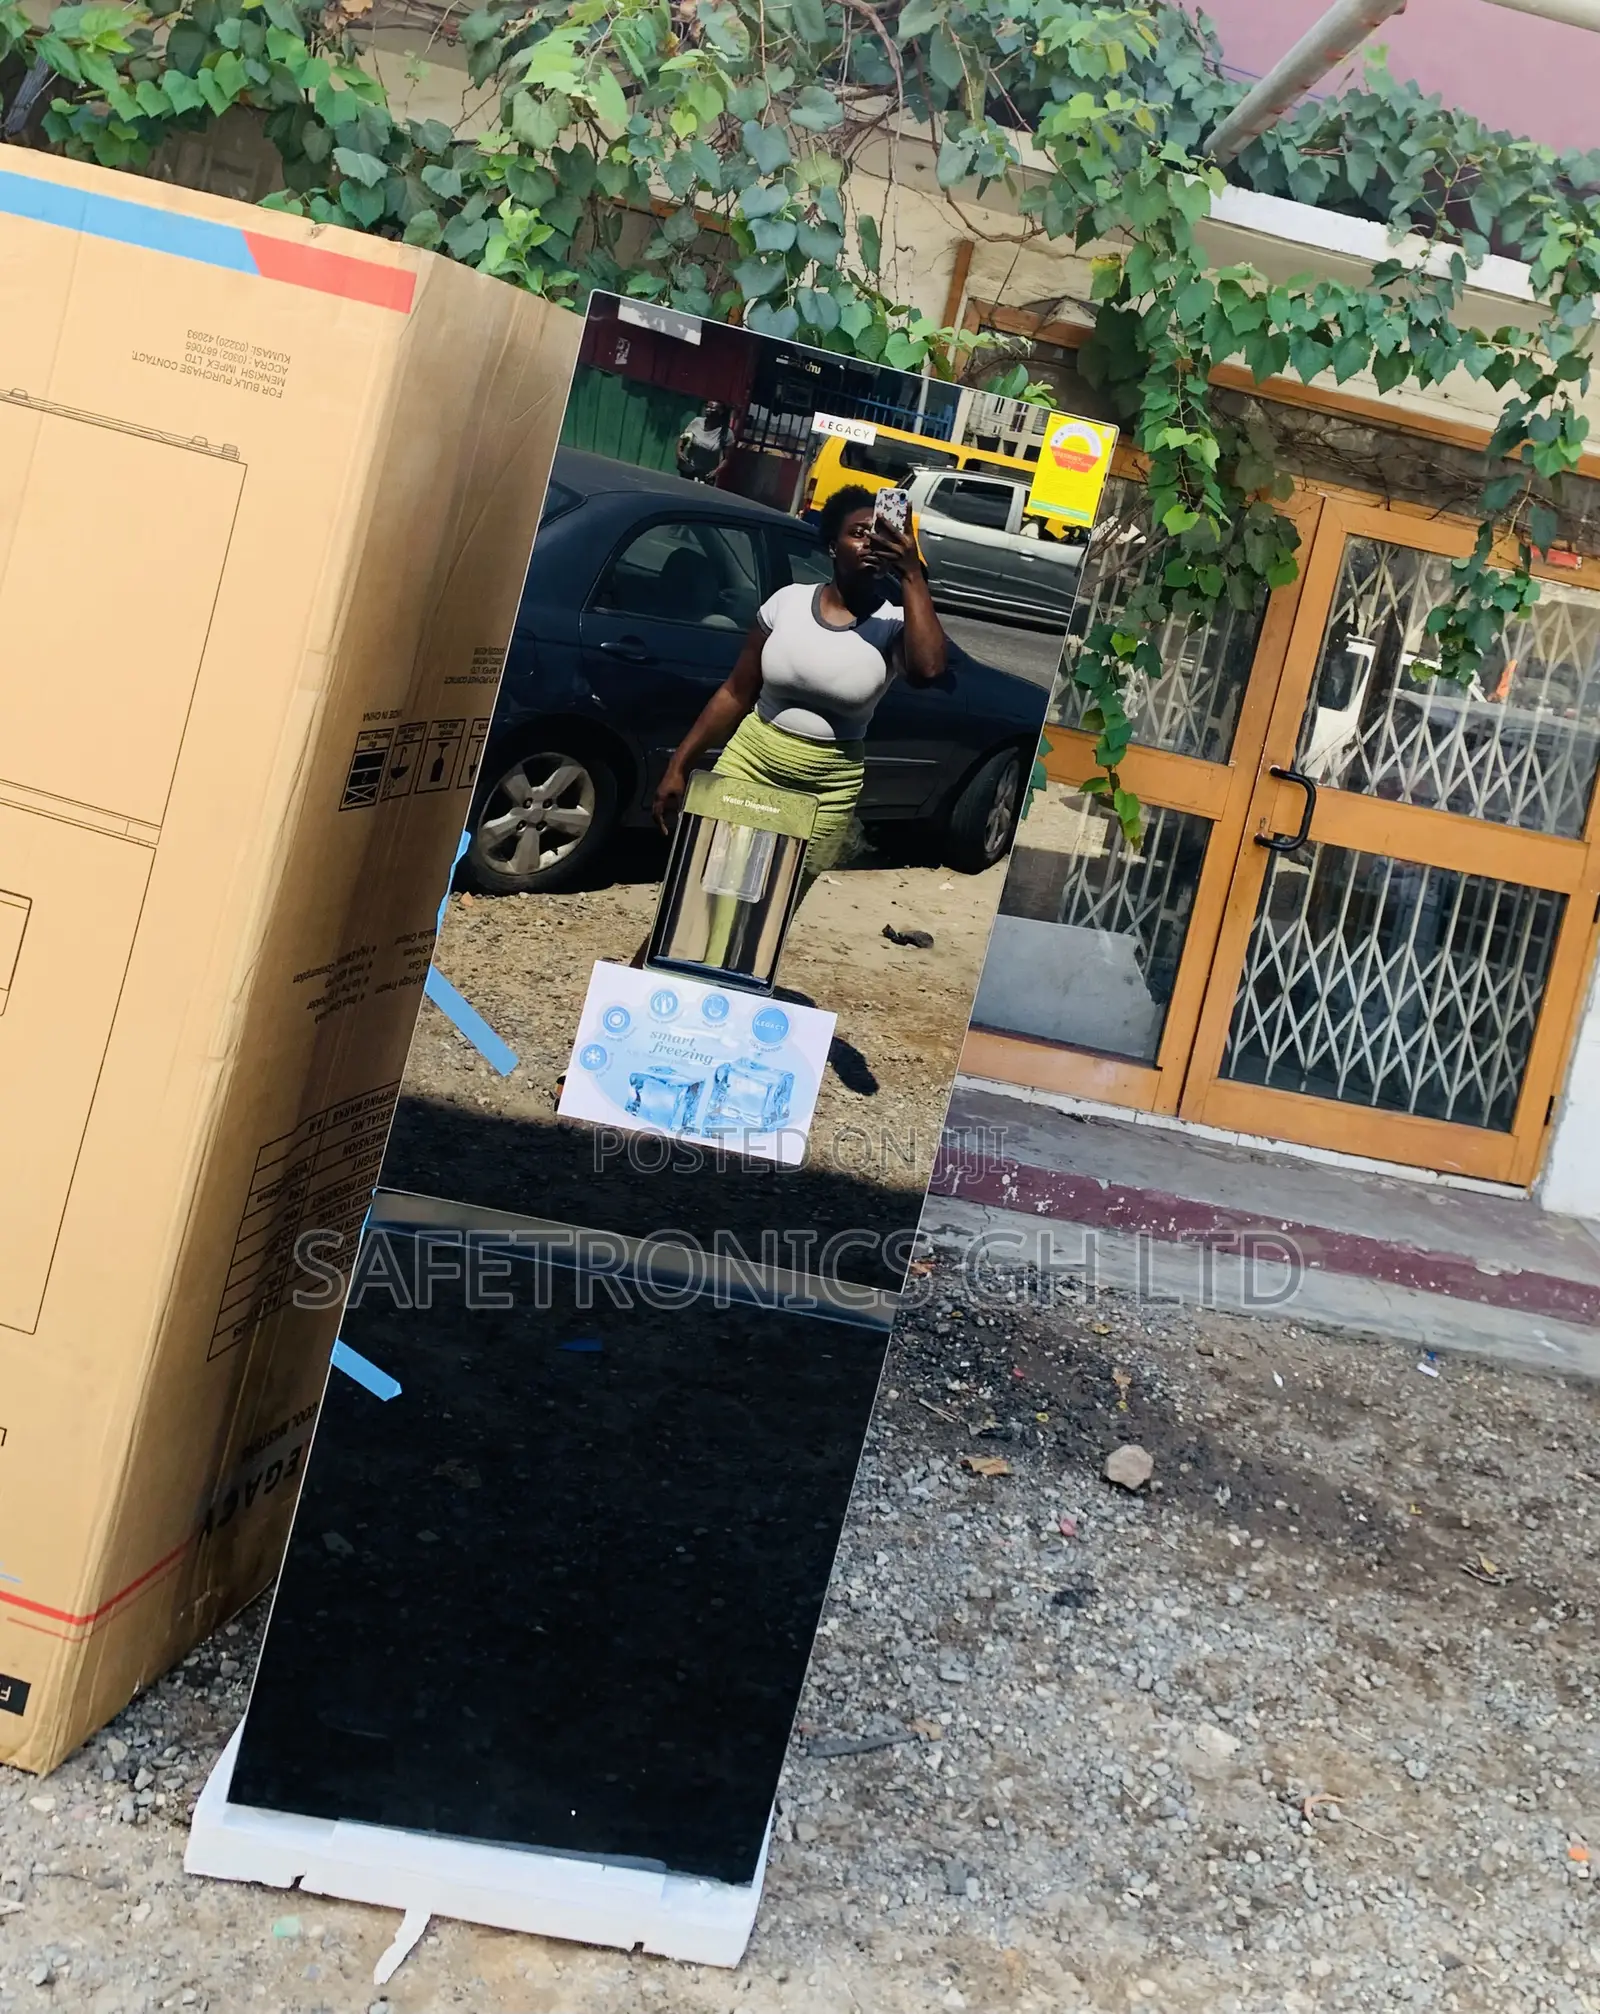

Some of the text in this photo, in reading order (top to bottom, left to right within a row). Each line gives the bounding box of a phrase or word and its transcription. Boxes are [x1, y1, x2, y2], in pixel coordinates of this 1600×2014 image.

[187, 329, 214, 343] 42093
[218, 350, 248, 365] (0302)
[251, 346, 291, 364] KUMASI:
[180, 363, 233, 386] PURCHASE
[185, 353, 286, 387] MENKISH IMPEX LTD
[234, 378, 260, 392] BULK
[262, 386, 283, 399] FOR
[818, 419, 870, 440] LEGACY
[723, 795, 781, 814] Water Dispenser
[650, 1031, 695, 1047] smart
[649, 1041, 713, 1066] freezing
[367, 1109, 393, 1126] ERIAL
[197, 1445, 303, 1547] EGACY
